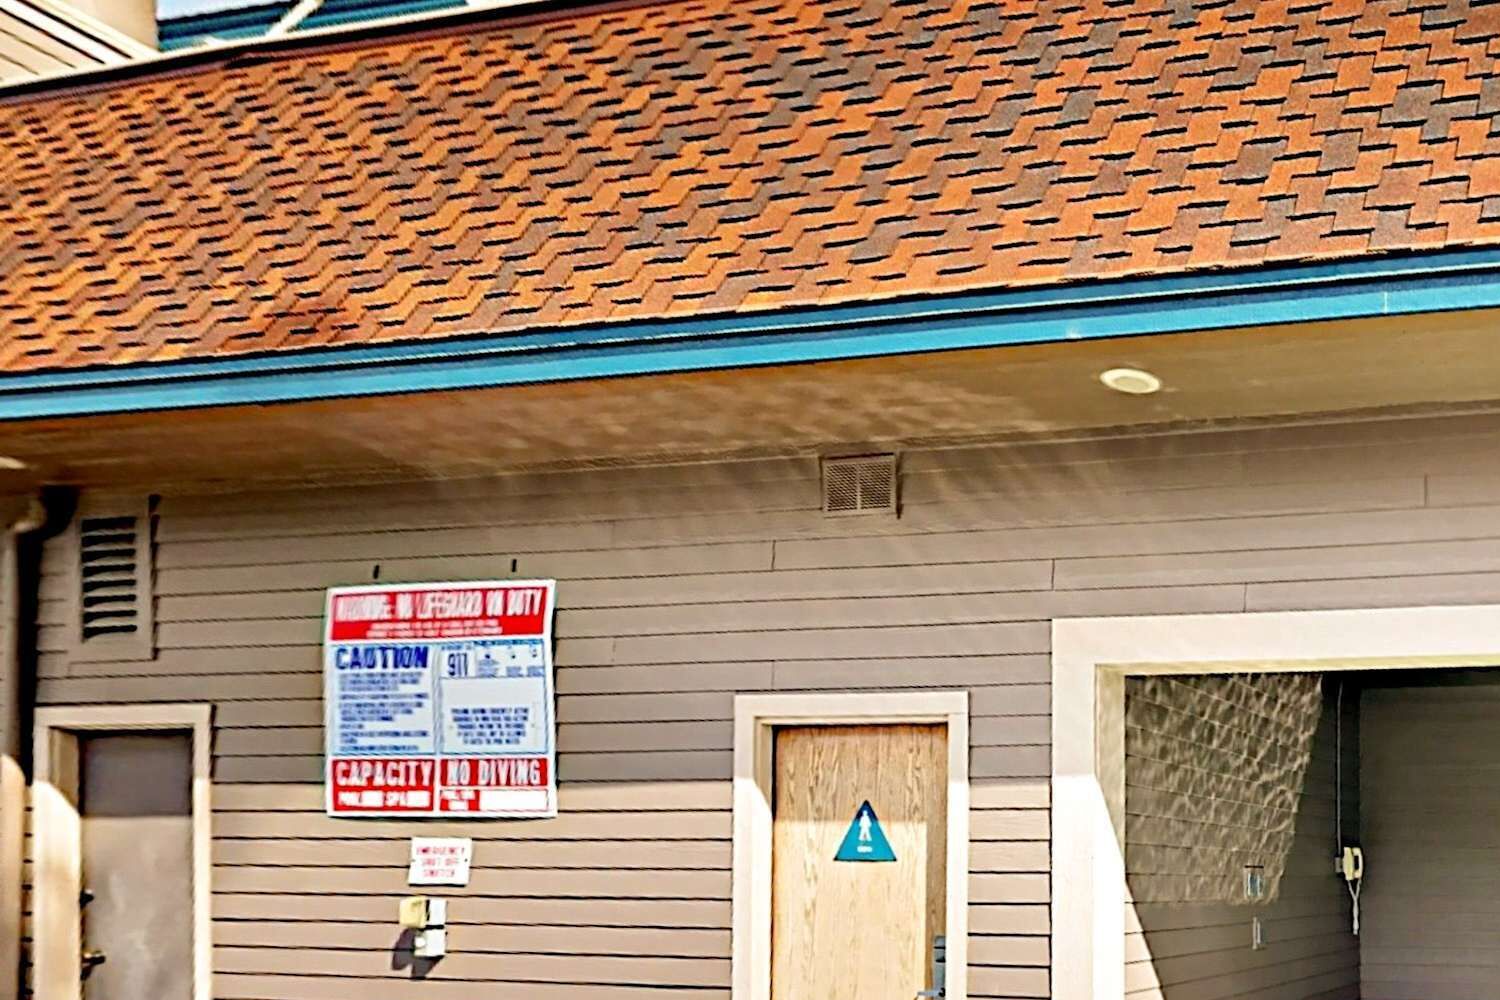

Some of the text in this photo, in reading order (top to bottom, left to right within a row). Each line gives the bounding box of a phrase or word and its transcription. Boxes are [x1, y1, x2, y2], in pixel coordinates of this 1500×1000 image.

[506, 588, 542, 616] DUTY
[336, 646, 428, 669] CAUTION
[448, 653, 467, 676] 911
[336, 761, 432, 786] CAPACITY
[447, 760, 540, 786] NO DIVING
